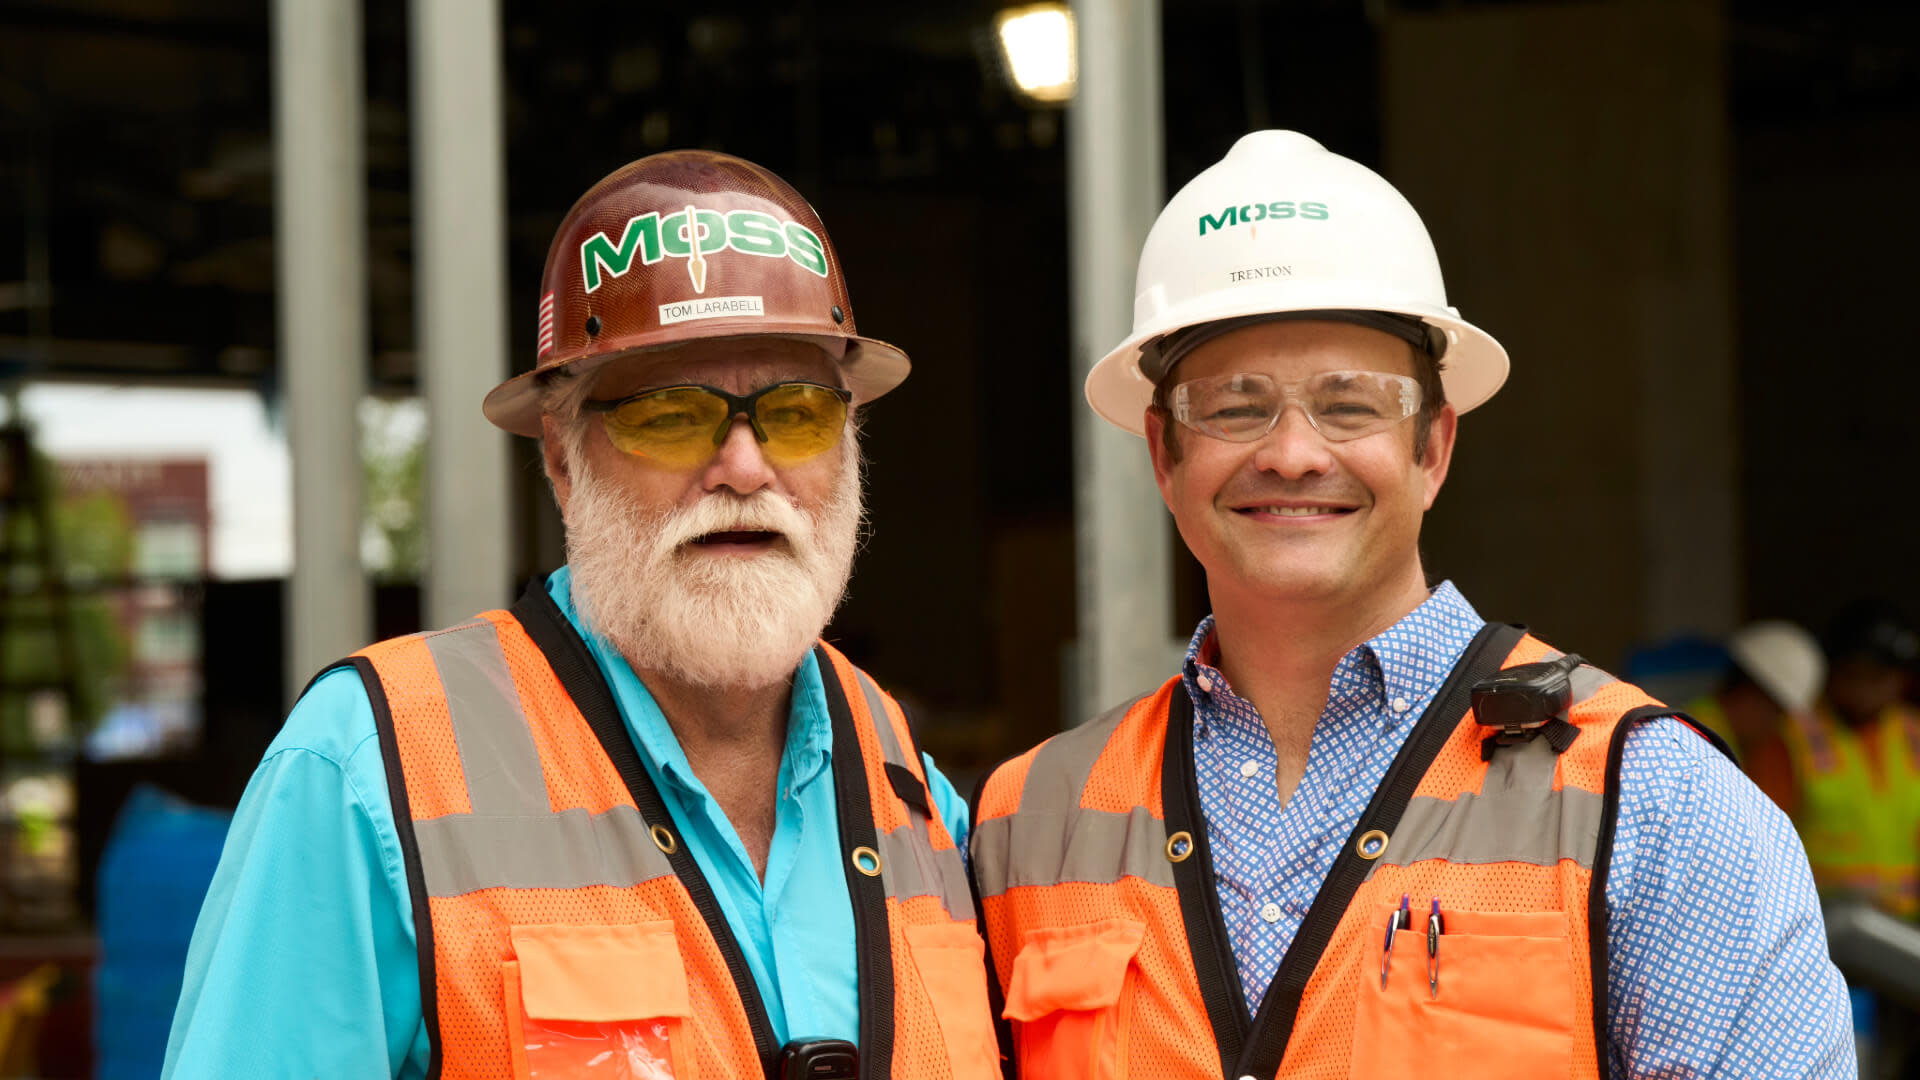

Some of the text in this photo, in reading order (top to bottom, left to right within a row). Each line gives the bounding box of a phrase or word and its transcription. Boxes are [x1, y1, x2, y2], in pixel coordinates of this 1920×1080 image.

[1199, 201, 1330, 236] MOSS
[582, 209, 828, 293] MOSS
[1229, 265, 1292, 283] TRENTON
[663, 300, 761, 319] TOM LARABELL
